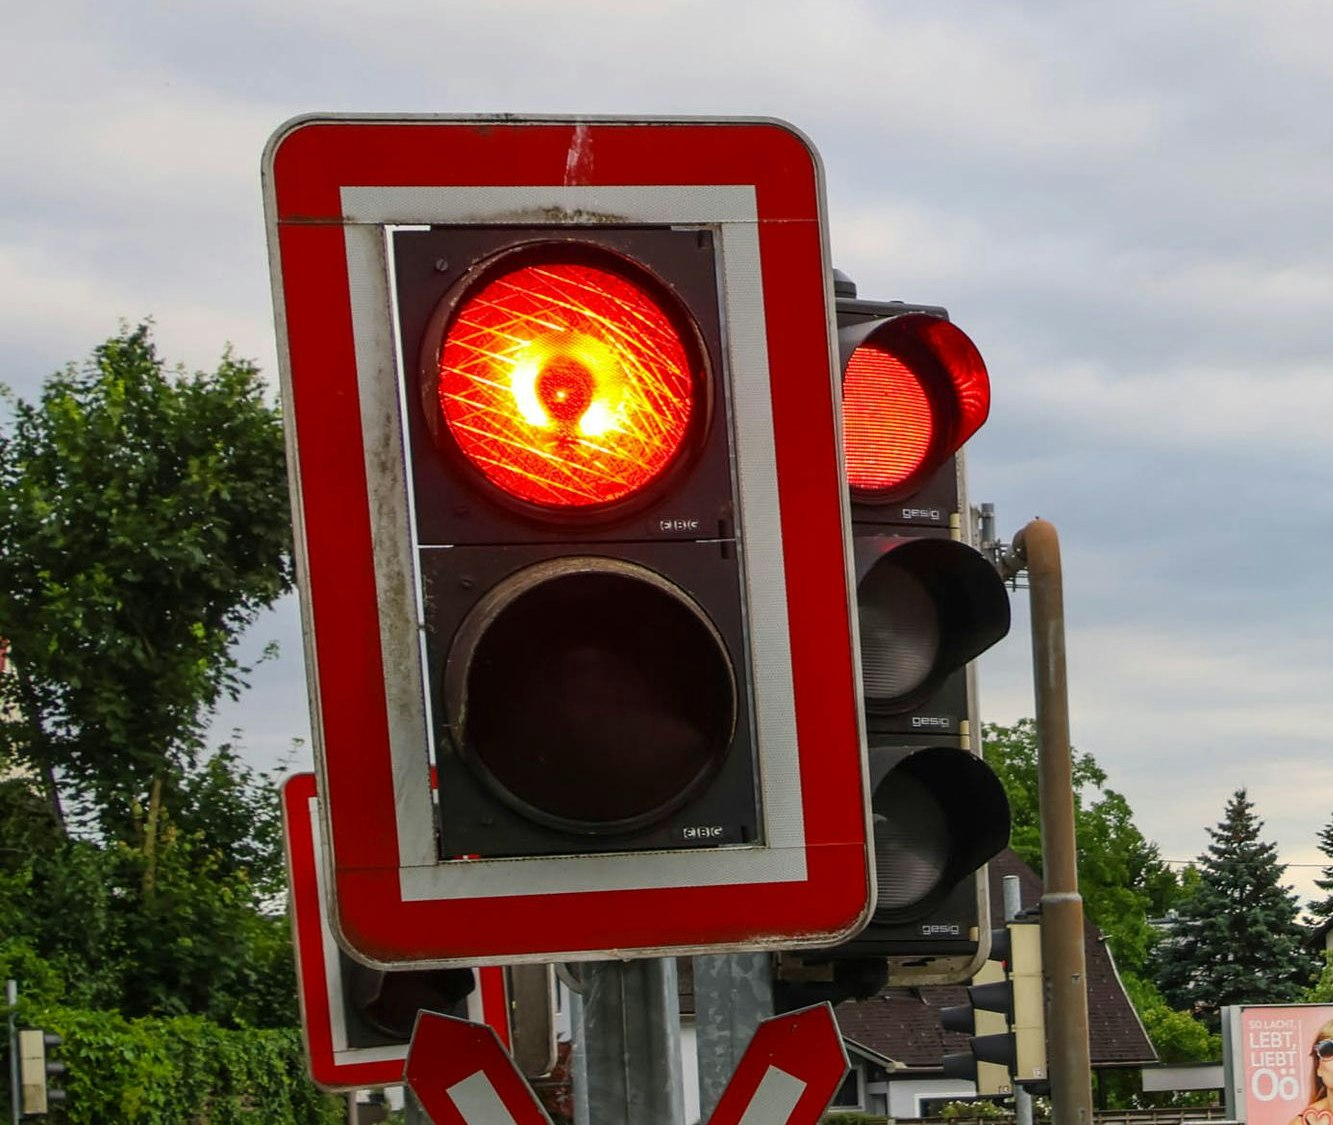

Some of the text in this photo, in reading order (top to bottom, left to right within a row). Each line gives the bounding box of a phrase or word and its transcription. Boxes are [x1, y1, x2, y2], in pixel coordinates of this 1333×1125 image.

[902, 507, 940, 520] gesig
[911, 716, 950, 728] gesig
[921, 922, 959, 935] gesig
[1249, 1031, 1297, 1050] LEBT,
[1250, 1051, 1297, 1067] LIEBT
